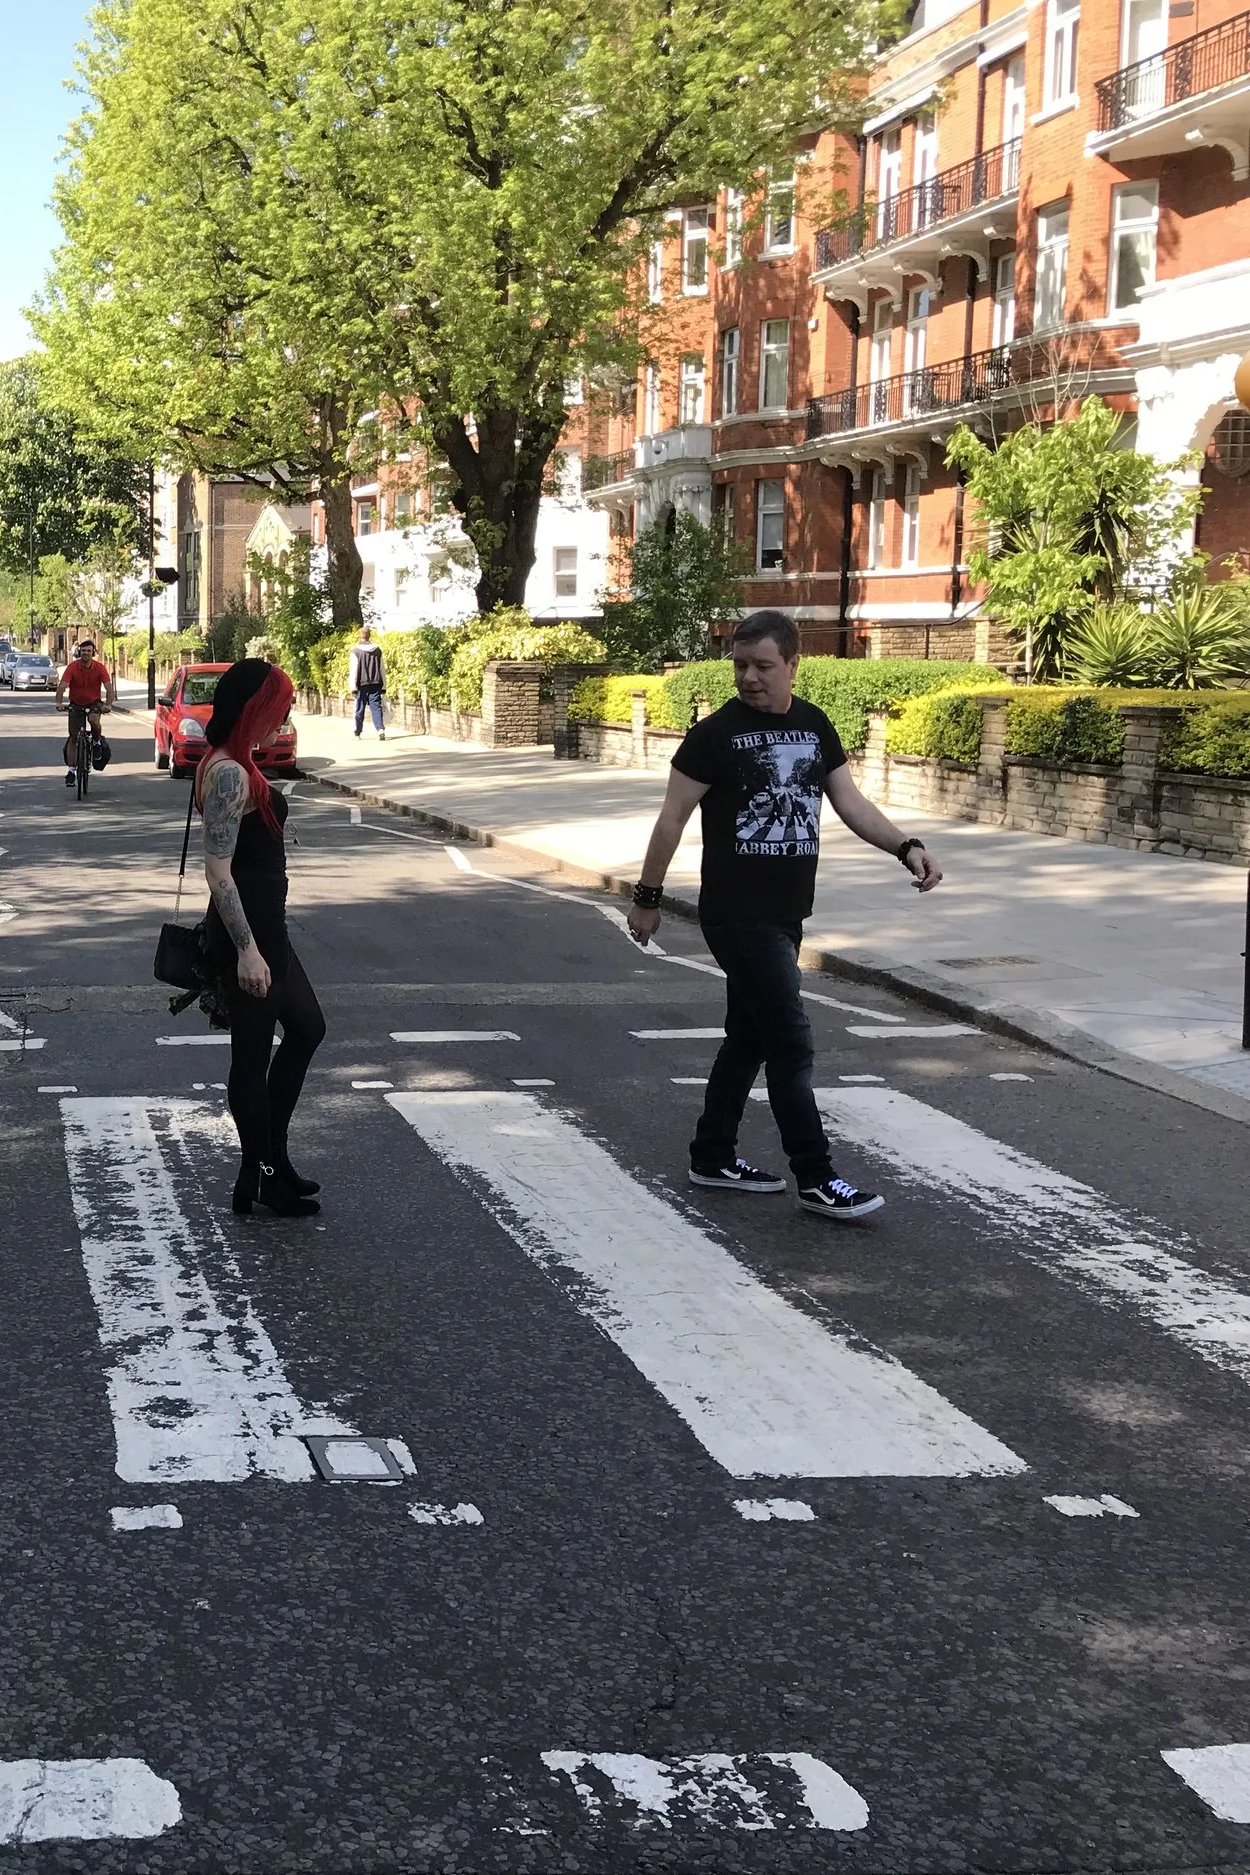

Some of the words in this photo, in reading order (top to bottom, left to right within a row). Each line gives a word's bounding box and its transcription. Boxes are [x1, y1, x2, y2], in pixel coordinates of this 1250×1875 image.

[734, 734, 763, 749] THE
[765, 731, 819, 745] BEATLES
[738, 842, 790, 856] ABBEY
